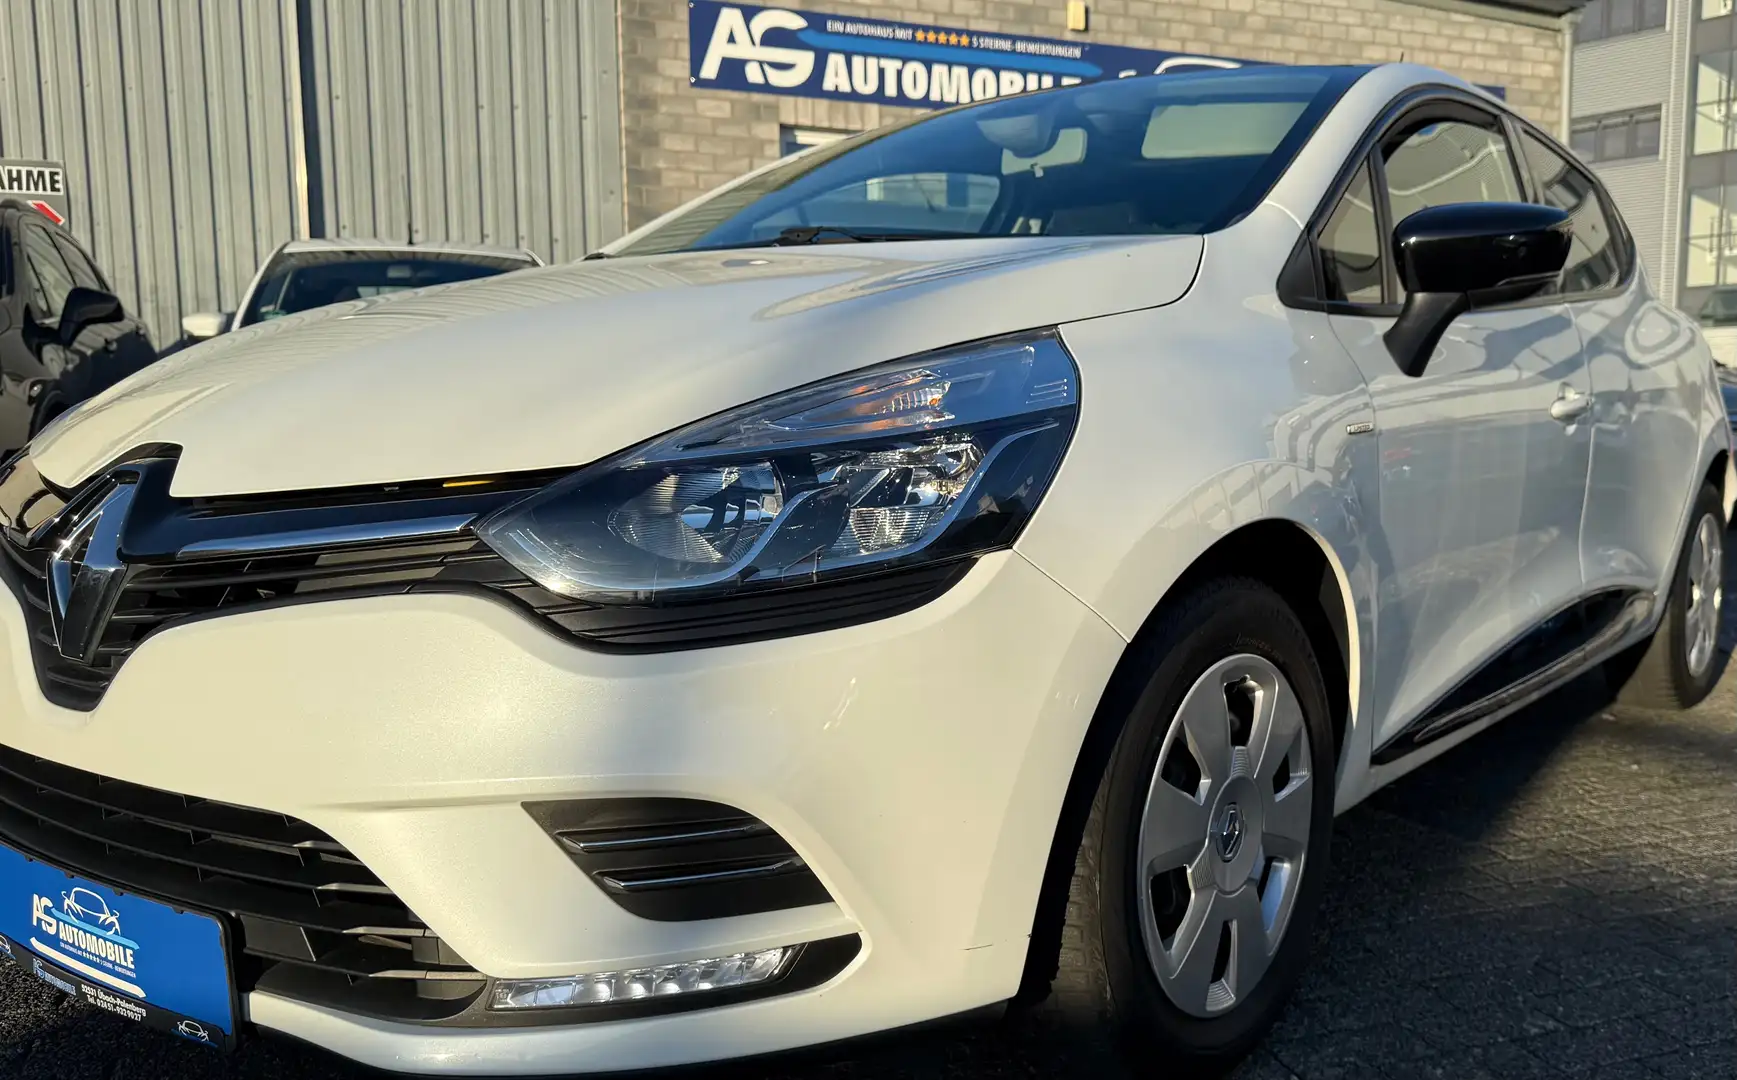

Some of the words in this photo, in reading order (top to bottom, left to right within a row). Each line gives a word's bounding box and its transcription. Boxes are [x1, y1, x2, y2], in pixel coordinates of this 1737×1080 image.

[699, 7, 815, 88] AS
[822, 52, 1083, 104] AUTOMOB
[32, 893, 57, 936] AS
[59, 921, 135, 970] AUTOMOBILE
